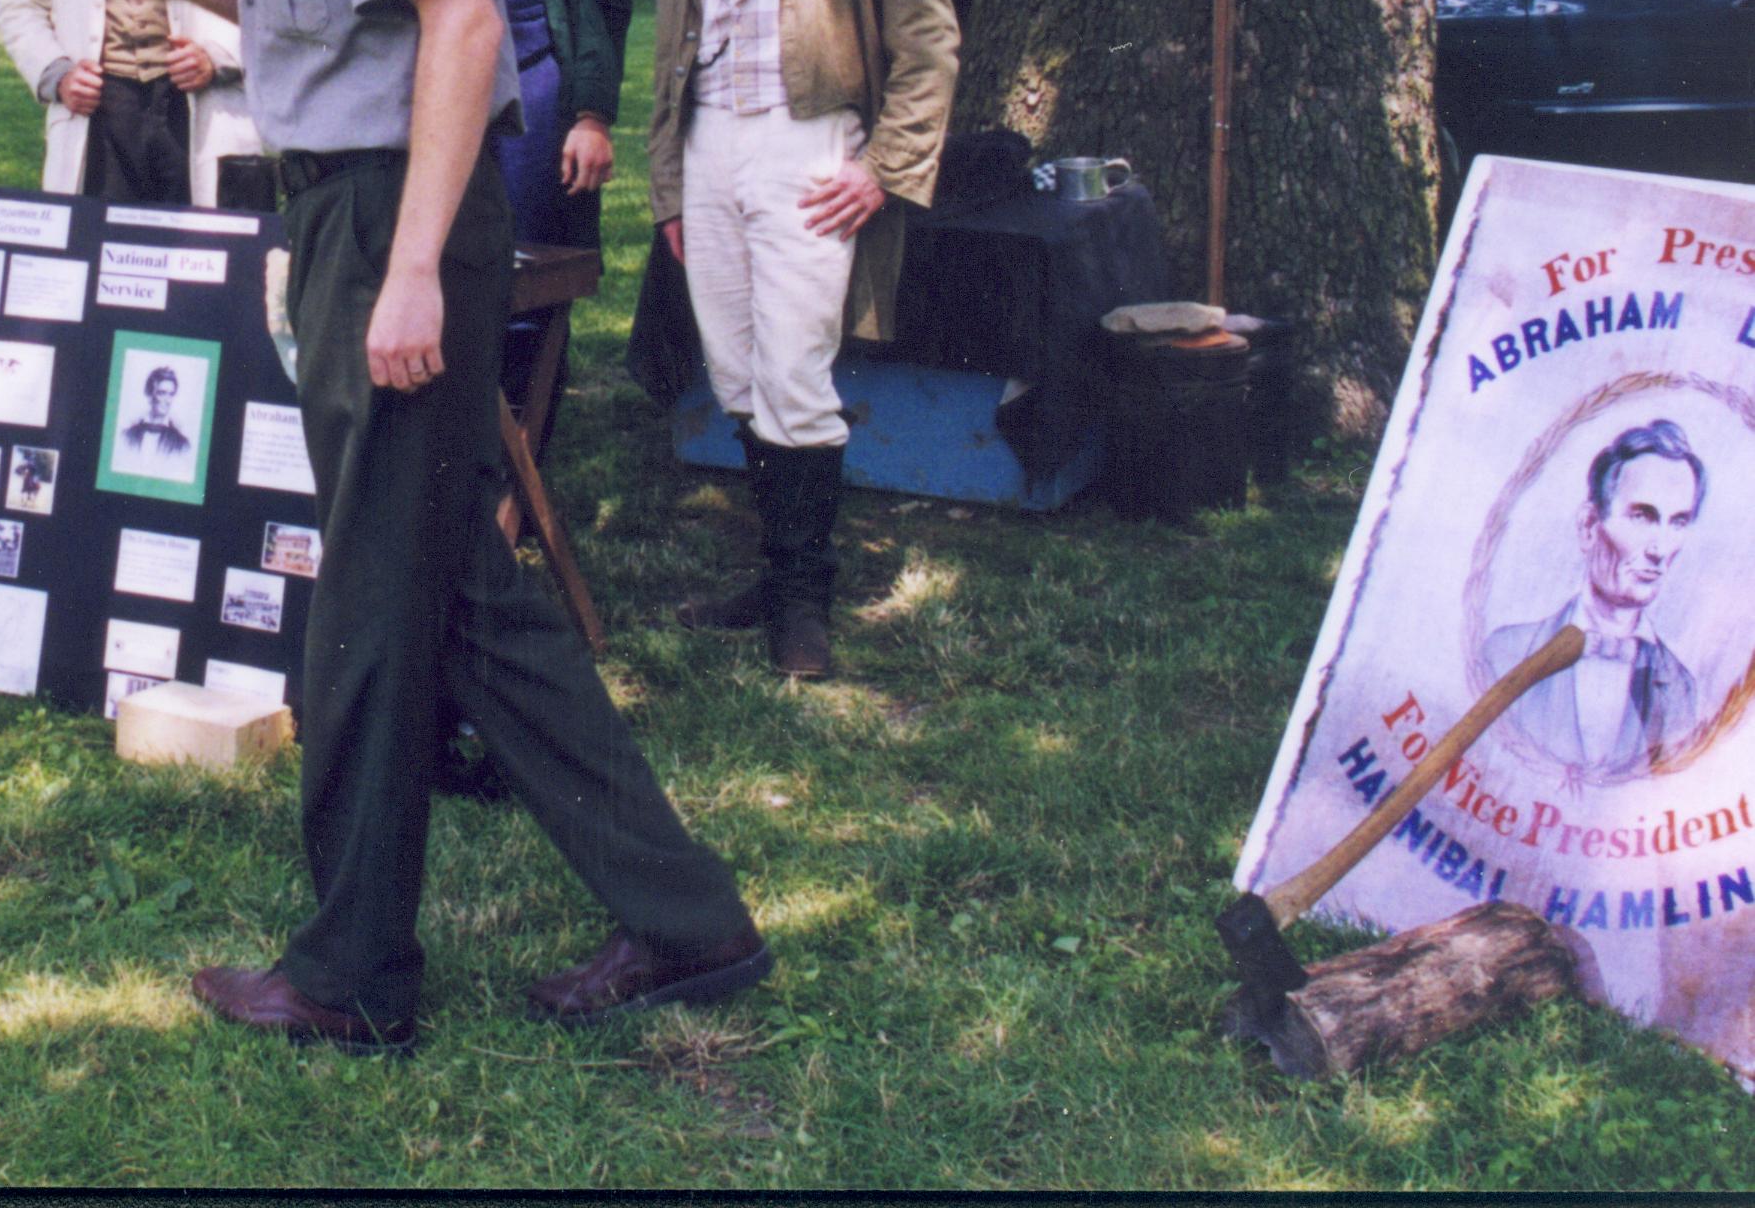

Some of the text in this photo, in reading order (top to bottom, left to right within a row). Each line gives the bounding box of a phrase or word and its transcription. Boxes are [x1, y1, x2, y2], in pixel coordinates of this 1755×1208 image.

[100, 281, 155, 299] Service
[105, 248, 215, 272] National Park
[1540, 248, 1617, 297] For
[1468, 291, 1684, 393] ABRAHAM
[1381, 689, 1755, 859] Fo Vice President
[1338, 735, 1755, 931] HANIBA HAMLIN
